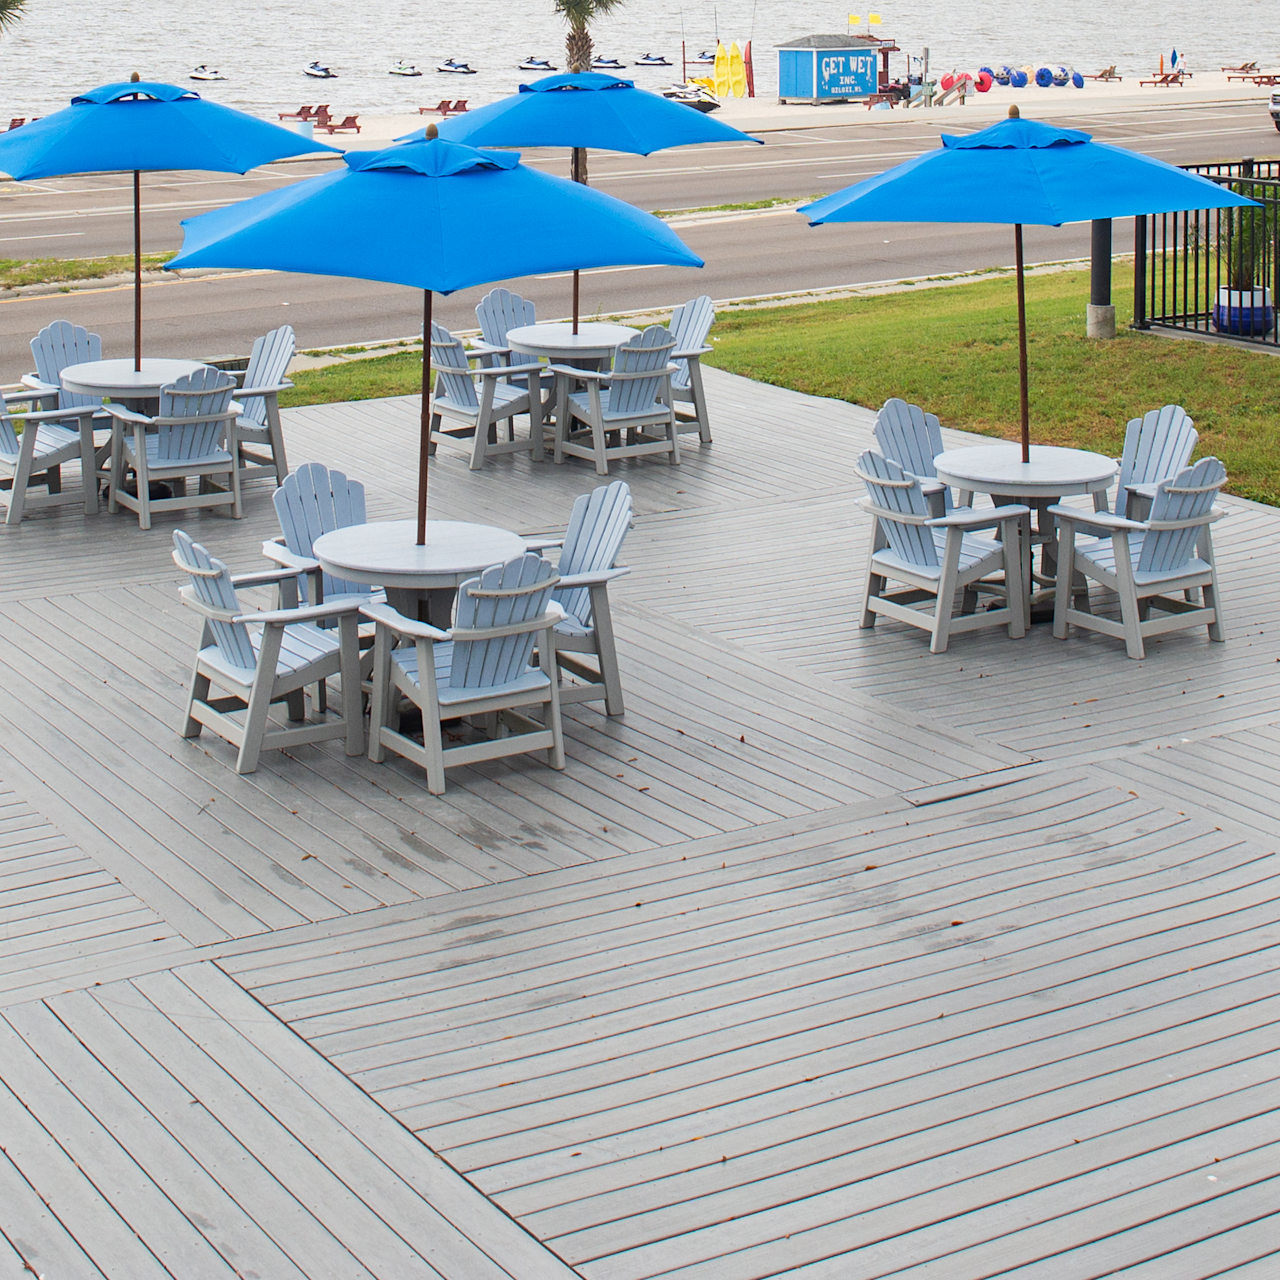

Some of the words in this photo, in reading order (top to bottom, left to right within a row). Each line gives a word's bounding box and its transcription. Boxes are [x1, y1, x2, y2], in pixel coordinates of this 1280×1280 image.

[822, 56, 846, 81] GET
[849, 55, 874, 79] WET
[839, 75, 857, 85] INC.
